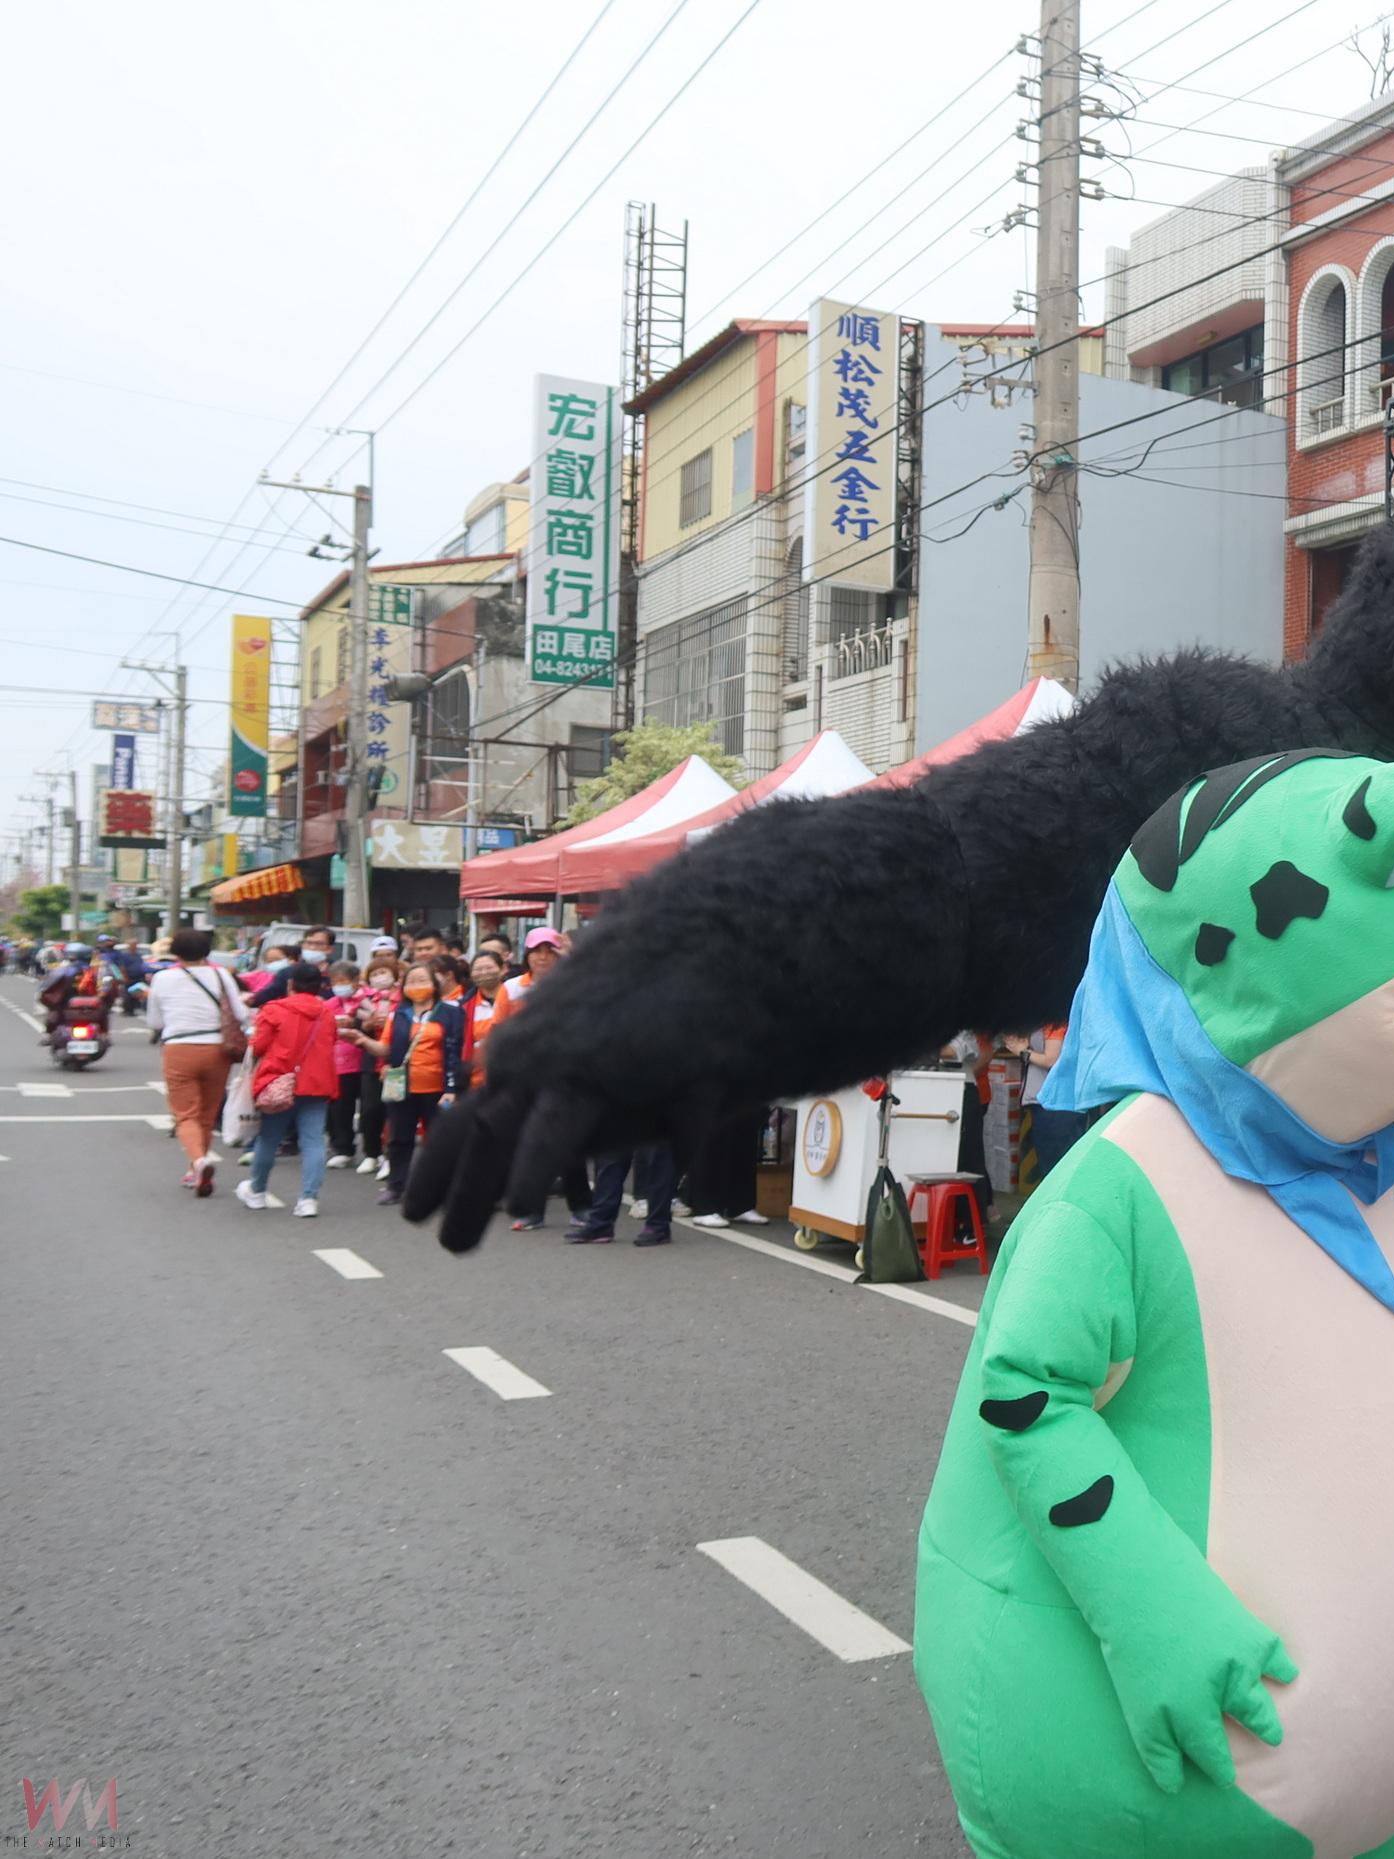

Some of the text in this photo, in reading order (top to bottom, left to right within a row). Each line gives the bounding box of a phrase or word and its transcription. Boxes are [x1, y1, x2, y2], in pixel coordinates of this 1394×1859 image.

[543, 392, 597, 619] 宏叡商行
[830, 312, 882, 541] 順松茂五金行
[536, 631, 612, 660] 田尾店
